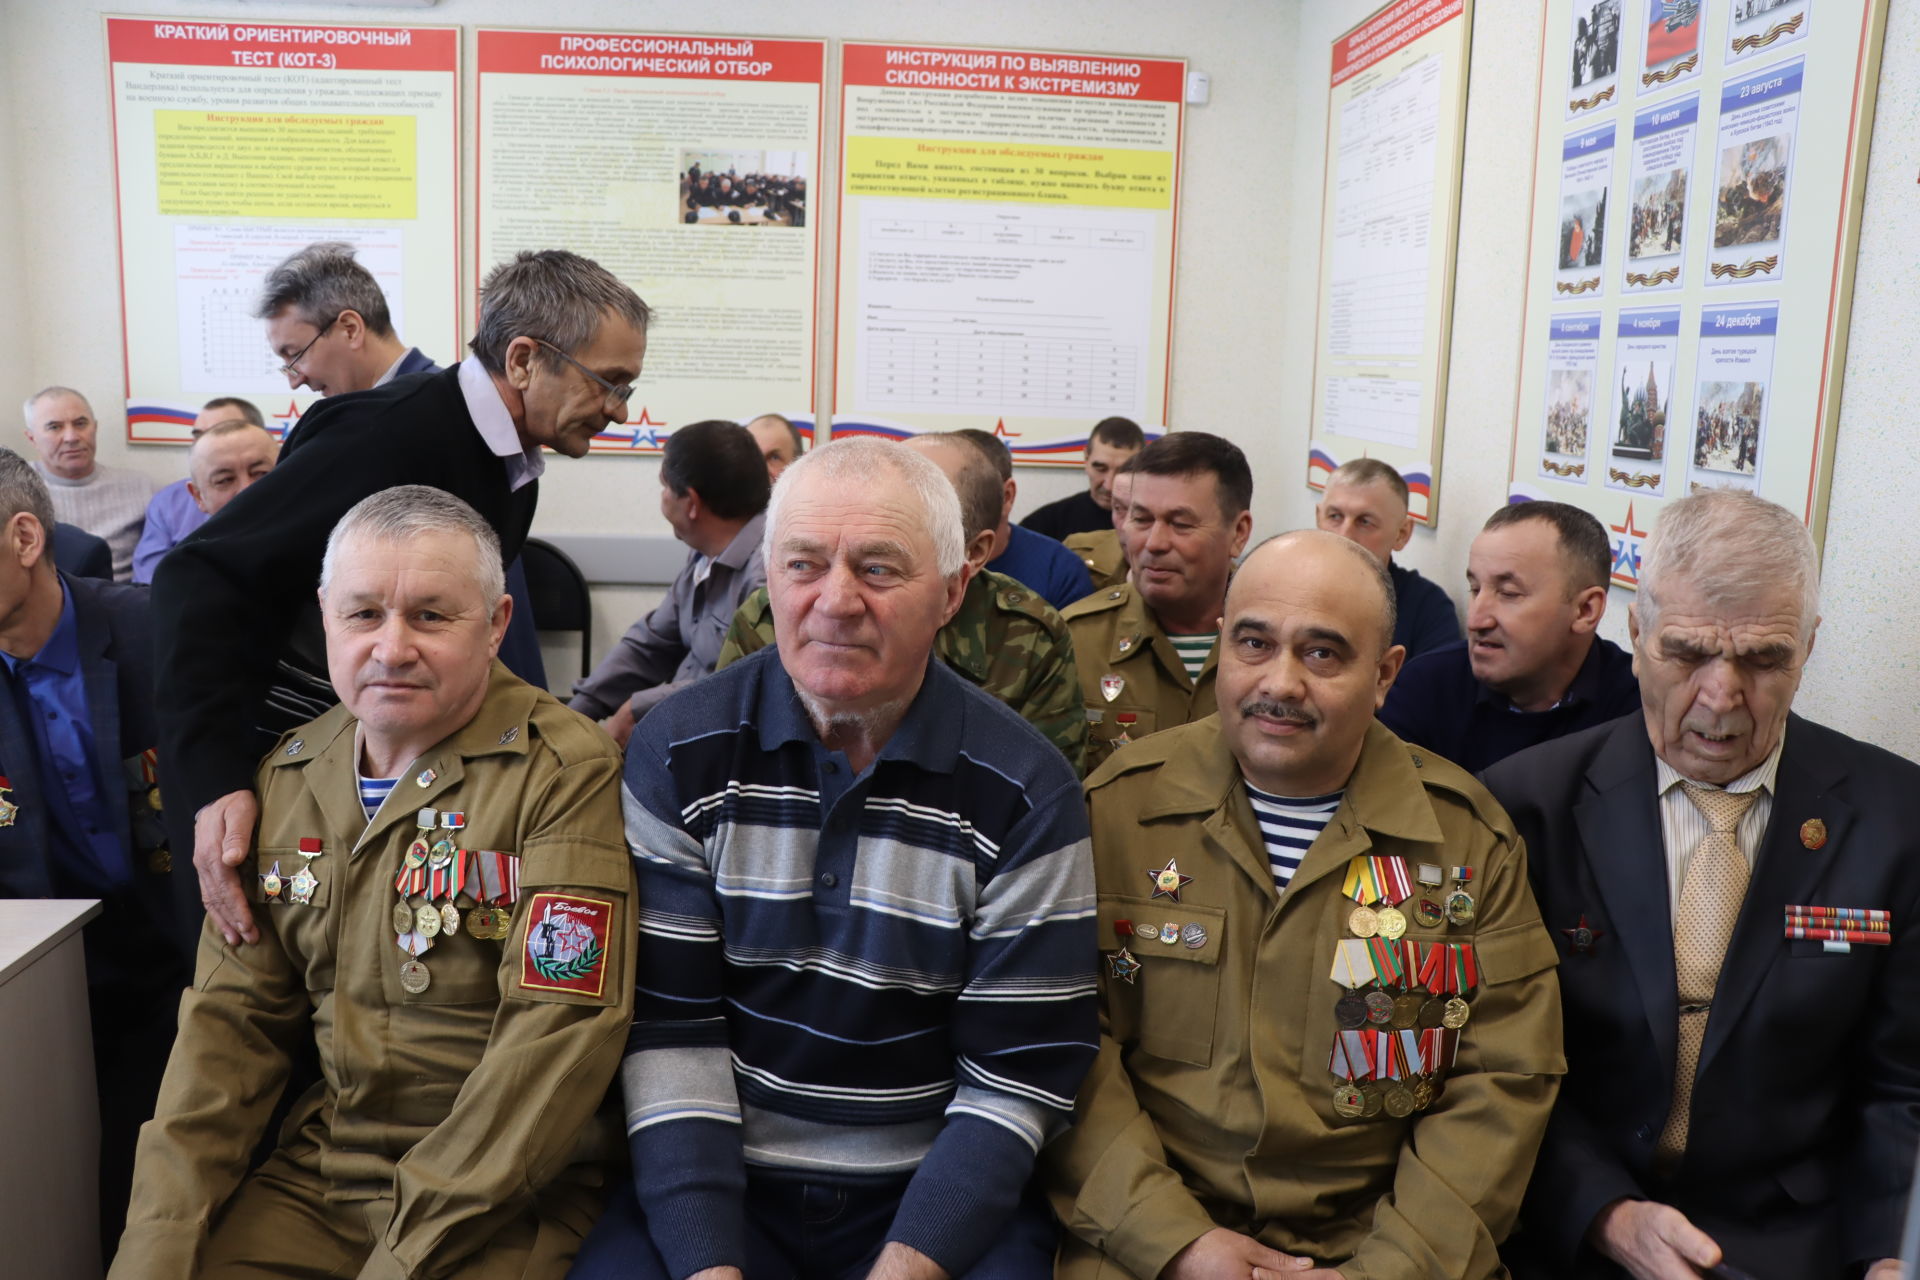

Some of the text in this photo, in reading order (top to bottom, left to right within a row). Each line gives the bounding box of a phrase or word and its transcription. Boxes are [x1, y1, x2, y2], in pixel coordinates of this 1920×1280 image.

[154, 24, 411, 46] КРАТКИЙ ОРИЕНТИРОВОЧНЫЙ
[560, 36, 754, 57] ПРОФЕССИОНАЛЬНЫЙ
[232, 50, 337, 69] ТЕСТ (КОТ-3)
[540, 54, 773, 76] ПСИХОЛОГИЧЕСКИЙ ОТБОР
[886, 50, 1141, 78] ИНСТРУКЦИЯ ПО ВЫЯВЛЕНИЮ
[886, 70, 1140, 97] СКЛОННОСТИ К ЭКСТРЕМИЗМУ
[1740, 77, 1783, 98] 23 августа
[1652, 110, 1680, 126] 10 июля
[1715, 312, 1761, 328] 24 декабря
[552, 901, 599, 916] Боевое
